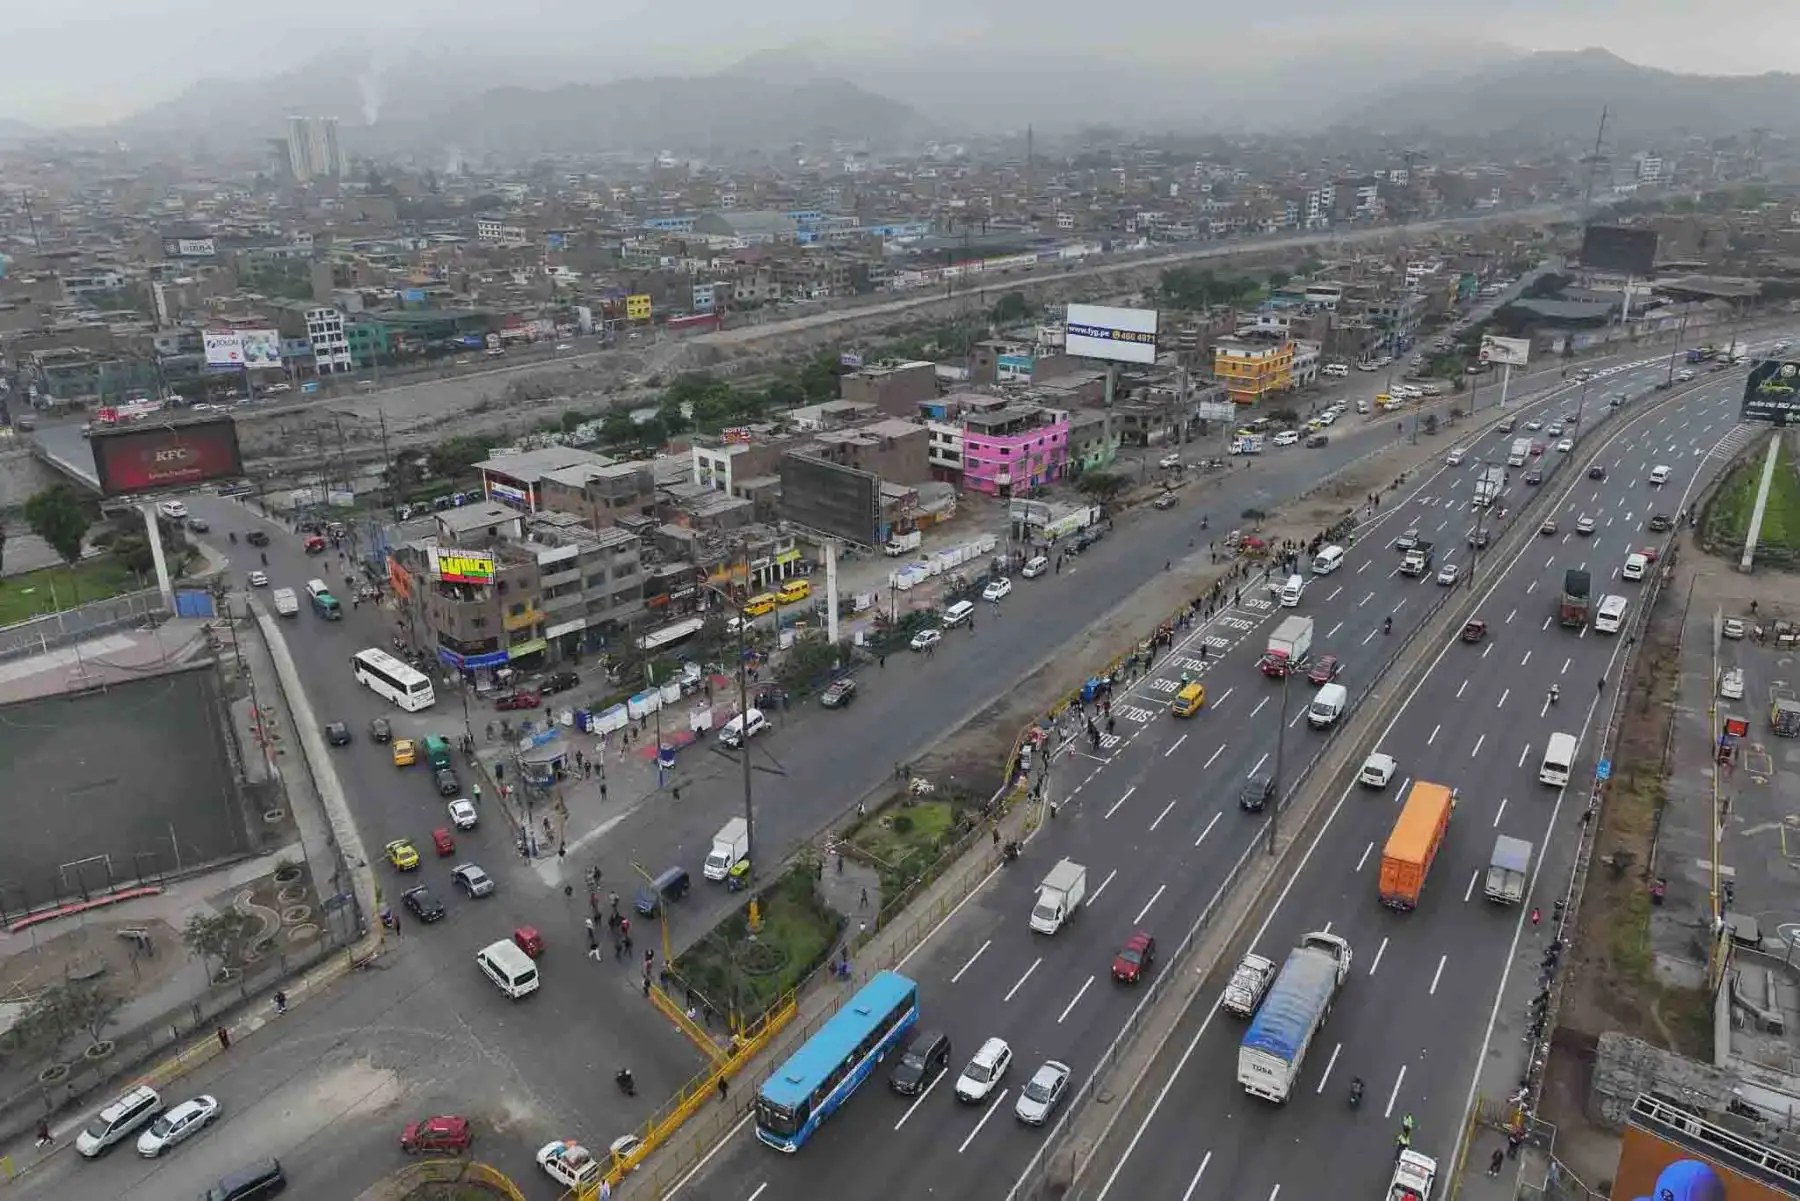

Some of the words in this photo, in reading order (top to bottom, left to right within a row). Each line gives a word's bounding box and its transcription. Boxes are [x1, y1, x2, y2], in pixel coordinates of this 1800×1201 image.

[156, 448, 187, 462] KFC
[1245, 598, 1272, 610] BUS
[1201, 635, 1229, 648] BUS
[1172, 656, 1208, 672] SOLO
[1151, 678, 1180, 693] BUS
[1113, 704, 1153, 722] SOLO
[1099, 732, 1121, 749] BU
